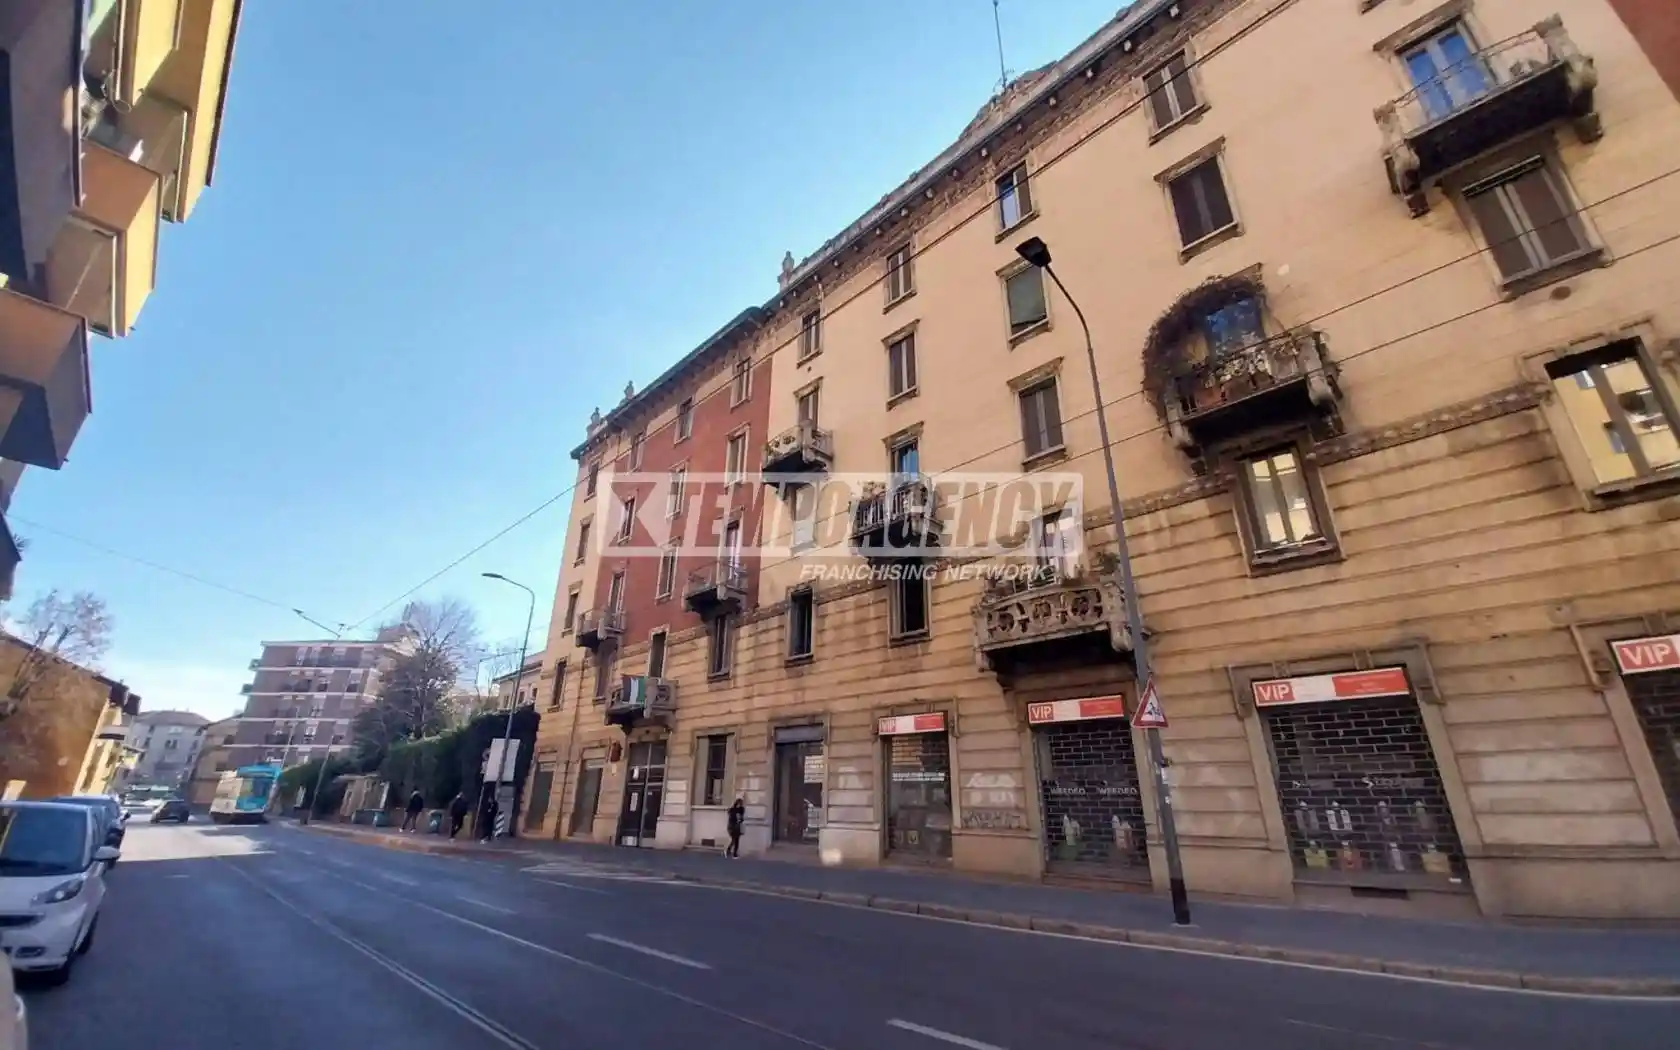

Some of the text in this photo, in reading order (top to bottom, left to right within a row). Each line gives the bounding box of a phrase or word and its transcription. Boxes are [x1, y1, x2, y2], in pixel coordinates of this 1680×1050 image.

[1621, 642, 1670, 666] VIP
[1258, 683, 1290, 701] VIP
[1031, 705, 1053, 720] VIP
[881, 719, 896, 733] VIP
